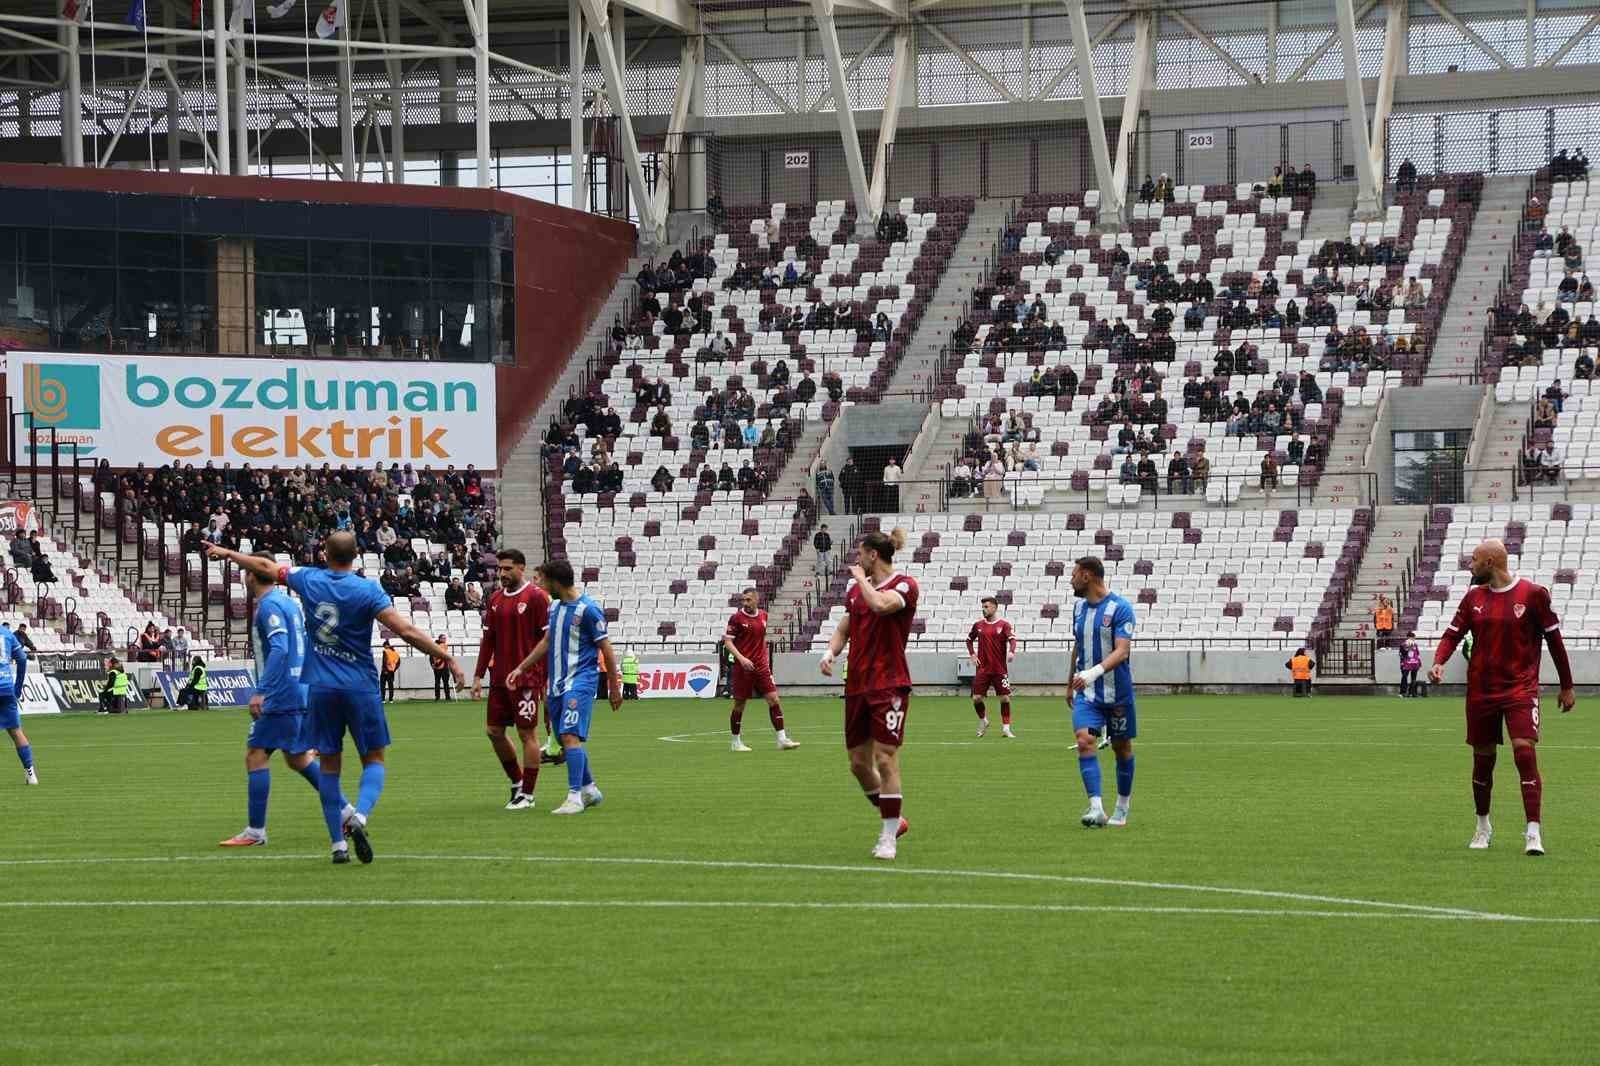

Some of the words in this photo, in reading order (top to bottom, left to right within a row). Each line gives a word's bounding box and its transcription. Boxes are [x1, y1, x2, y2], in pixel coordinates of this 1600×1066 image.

[1190, 136, 1212, 146] 203
[786, 155, 808, 165] 202
[126, 363, 477, 412] bozduman
[155, 413, 450, 459] elektrik
[1487, 491, 1497, 499] 21
[1391, 530, 1403, 538] 22
[314, 601, 338, 645] 2
[783, 612, 794, 620] 27
[518, 700, 537, 716] 20
[1531, 706, 1539, 726] 6
[563, 709, 579, 725] 20
[885, 710, 905, 730] 97
[1111, 717, 1127, 731] 52
